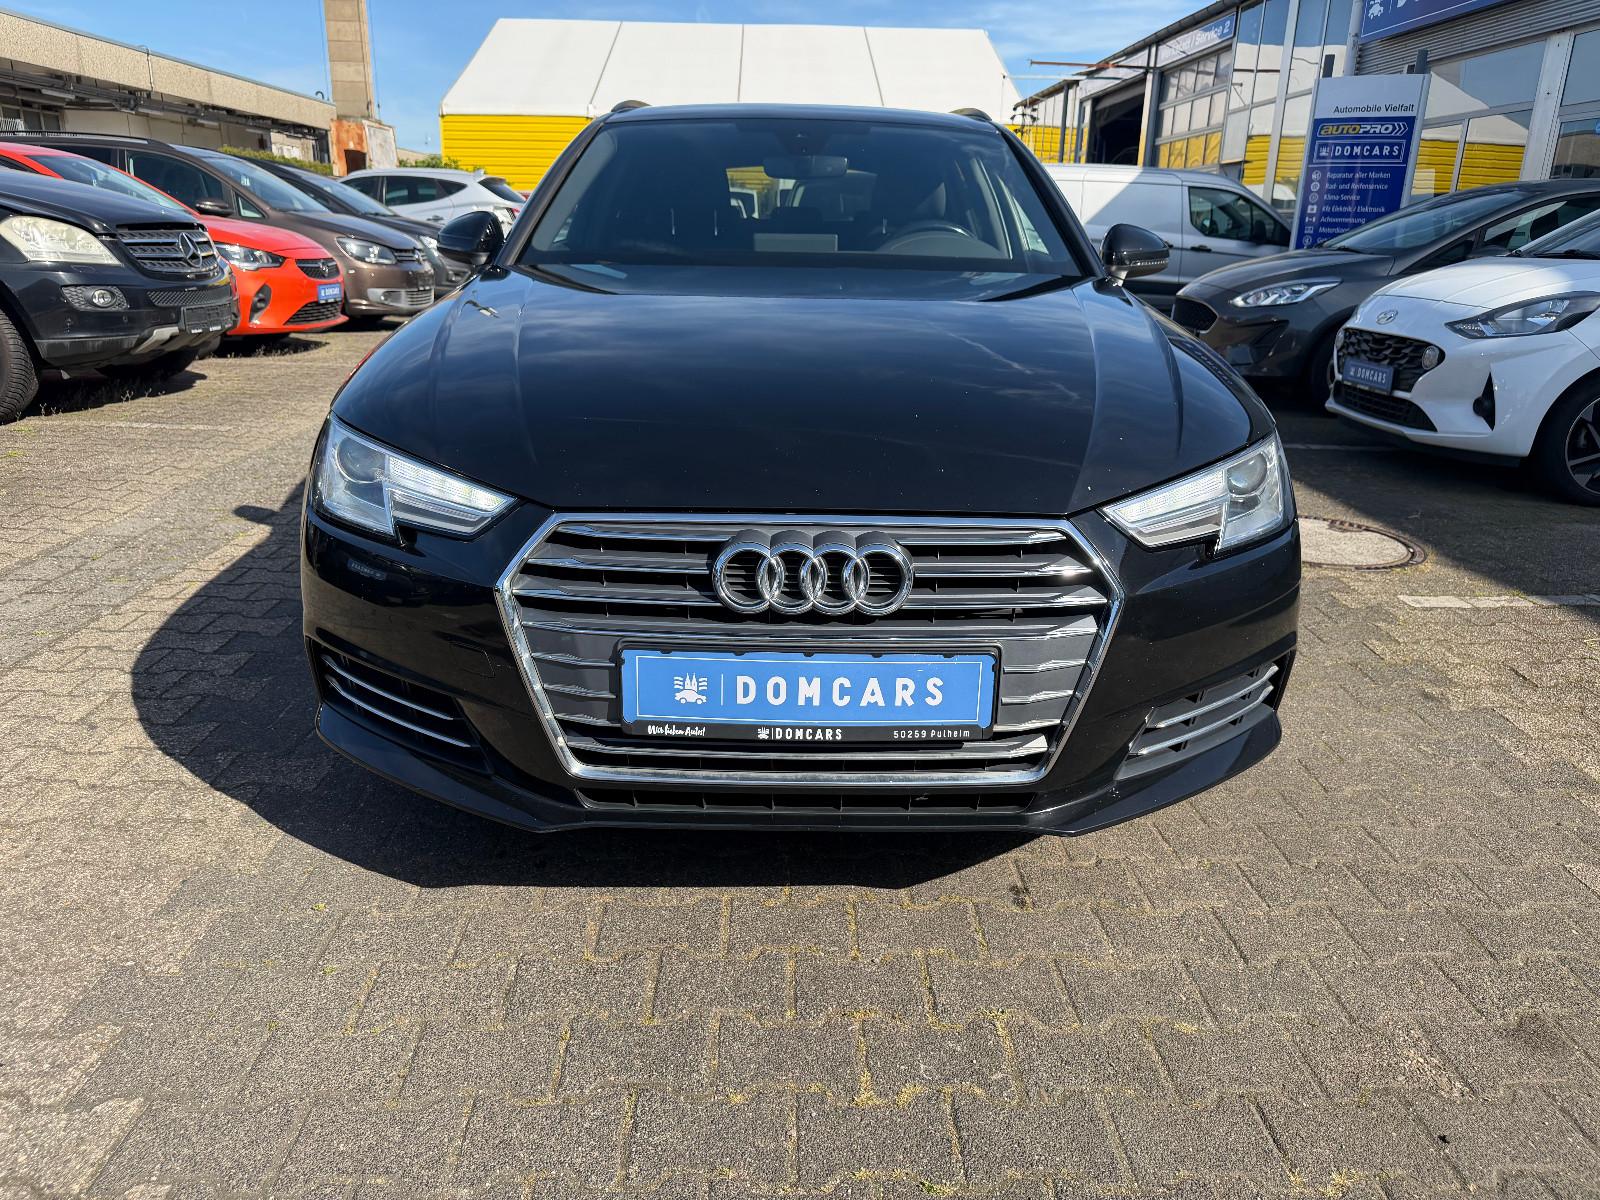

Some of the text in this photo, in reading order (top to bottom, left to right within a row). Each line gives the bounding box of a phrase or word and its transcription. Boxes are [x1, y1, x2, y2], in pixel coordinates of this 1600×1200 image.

[1223, 20, 1231, 33] 2
[1333, 103, 1415, 114] Automobile Vielfalt
[1334, 145, 1400, 156] DOMCARS
[1327, 171, 1354, 179] Reparatur
[1368, 171, 1391, 179] Marken
[1357, 367, 1386, 384] DOMCARS
[736, 675, 944, 707] DOMCARS
[776, 727, 843, 740] DOMCARS
[893, 729, 970, 739] 50259 Pulheim
